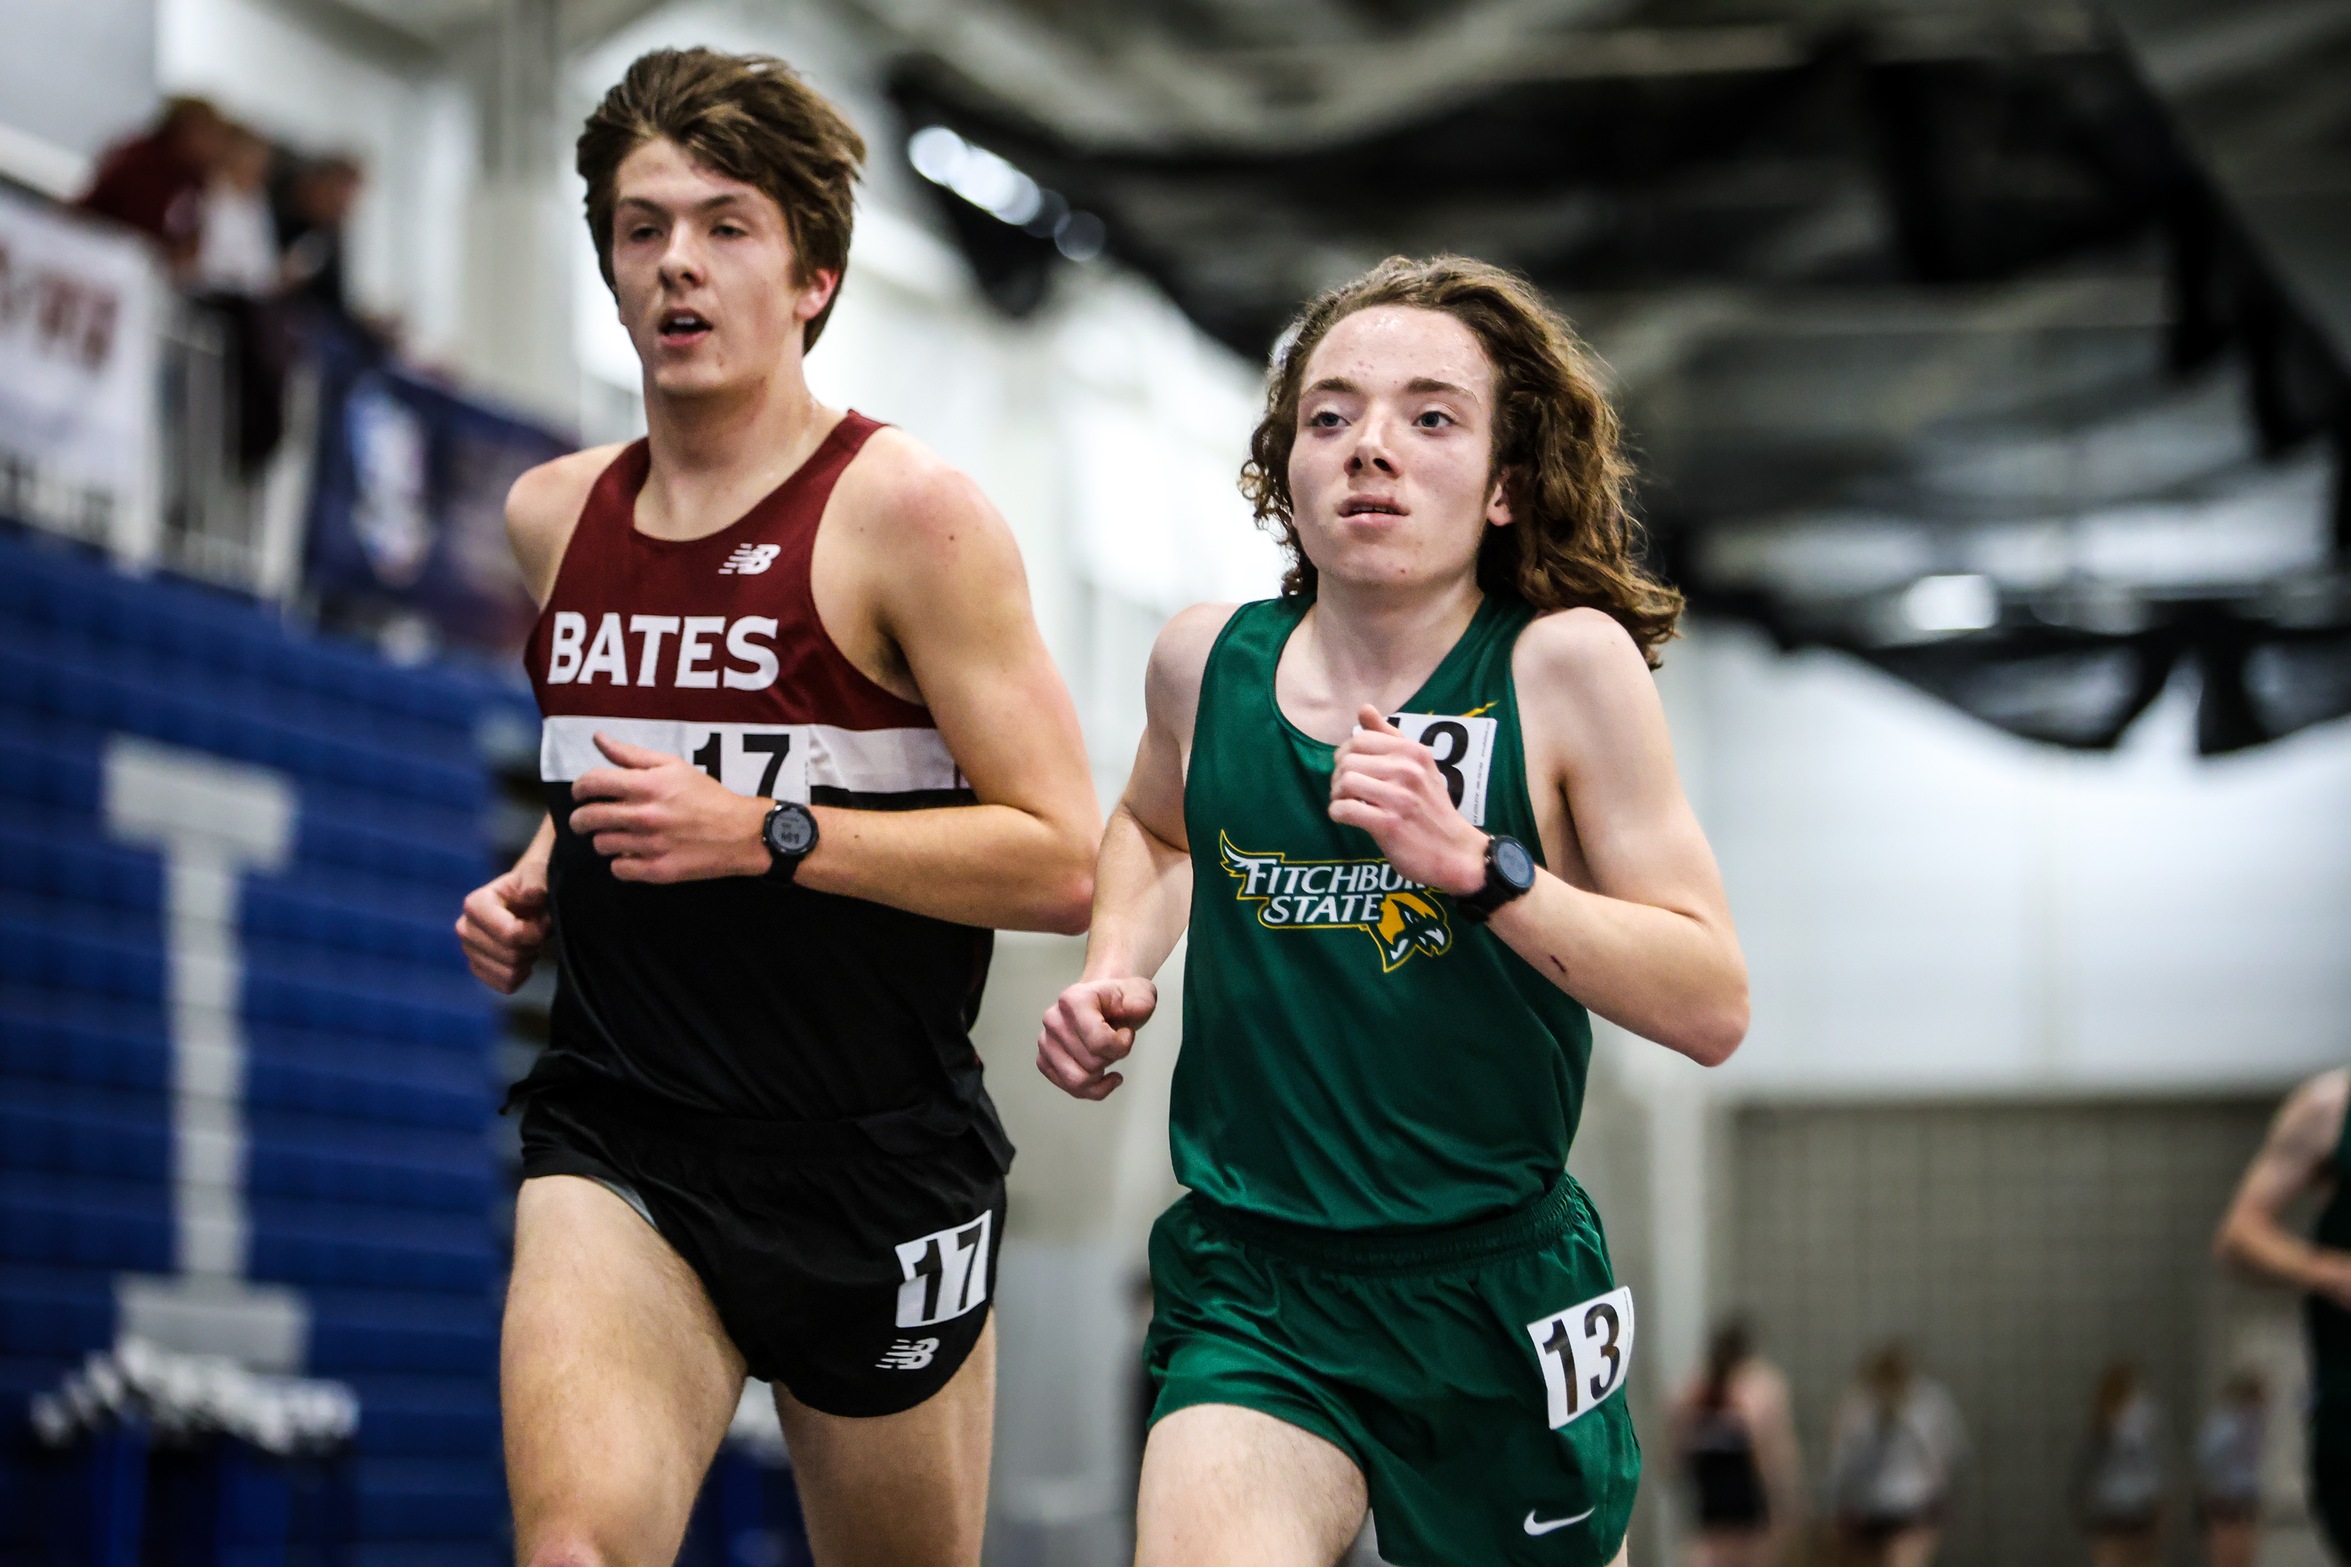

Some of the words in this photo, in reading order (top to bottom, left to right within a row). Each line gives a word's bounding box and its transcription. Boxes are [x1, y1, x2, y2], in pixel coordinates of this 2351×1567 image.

[547, 611, 780, 691] BATES
[1387, 716, 1469, 811] 3
[1236, 857, 1425, 895] FITCHBU
[1263, 893, 1383, 923] STATE
[913, 1222, 983, 1321] 17
[1542, 1303, 1621, 1416] 13
